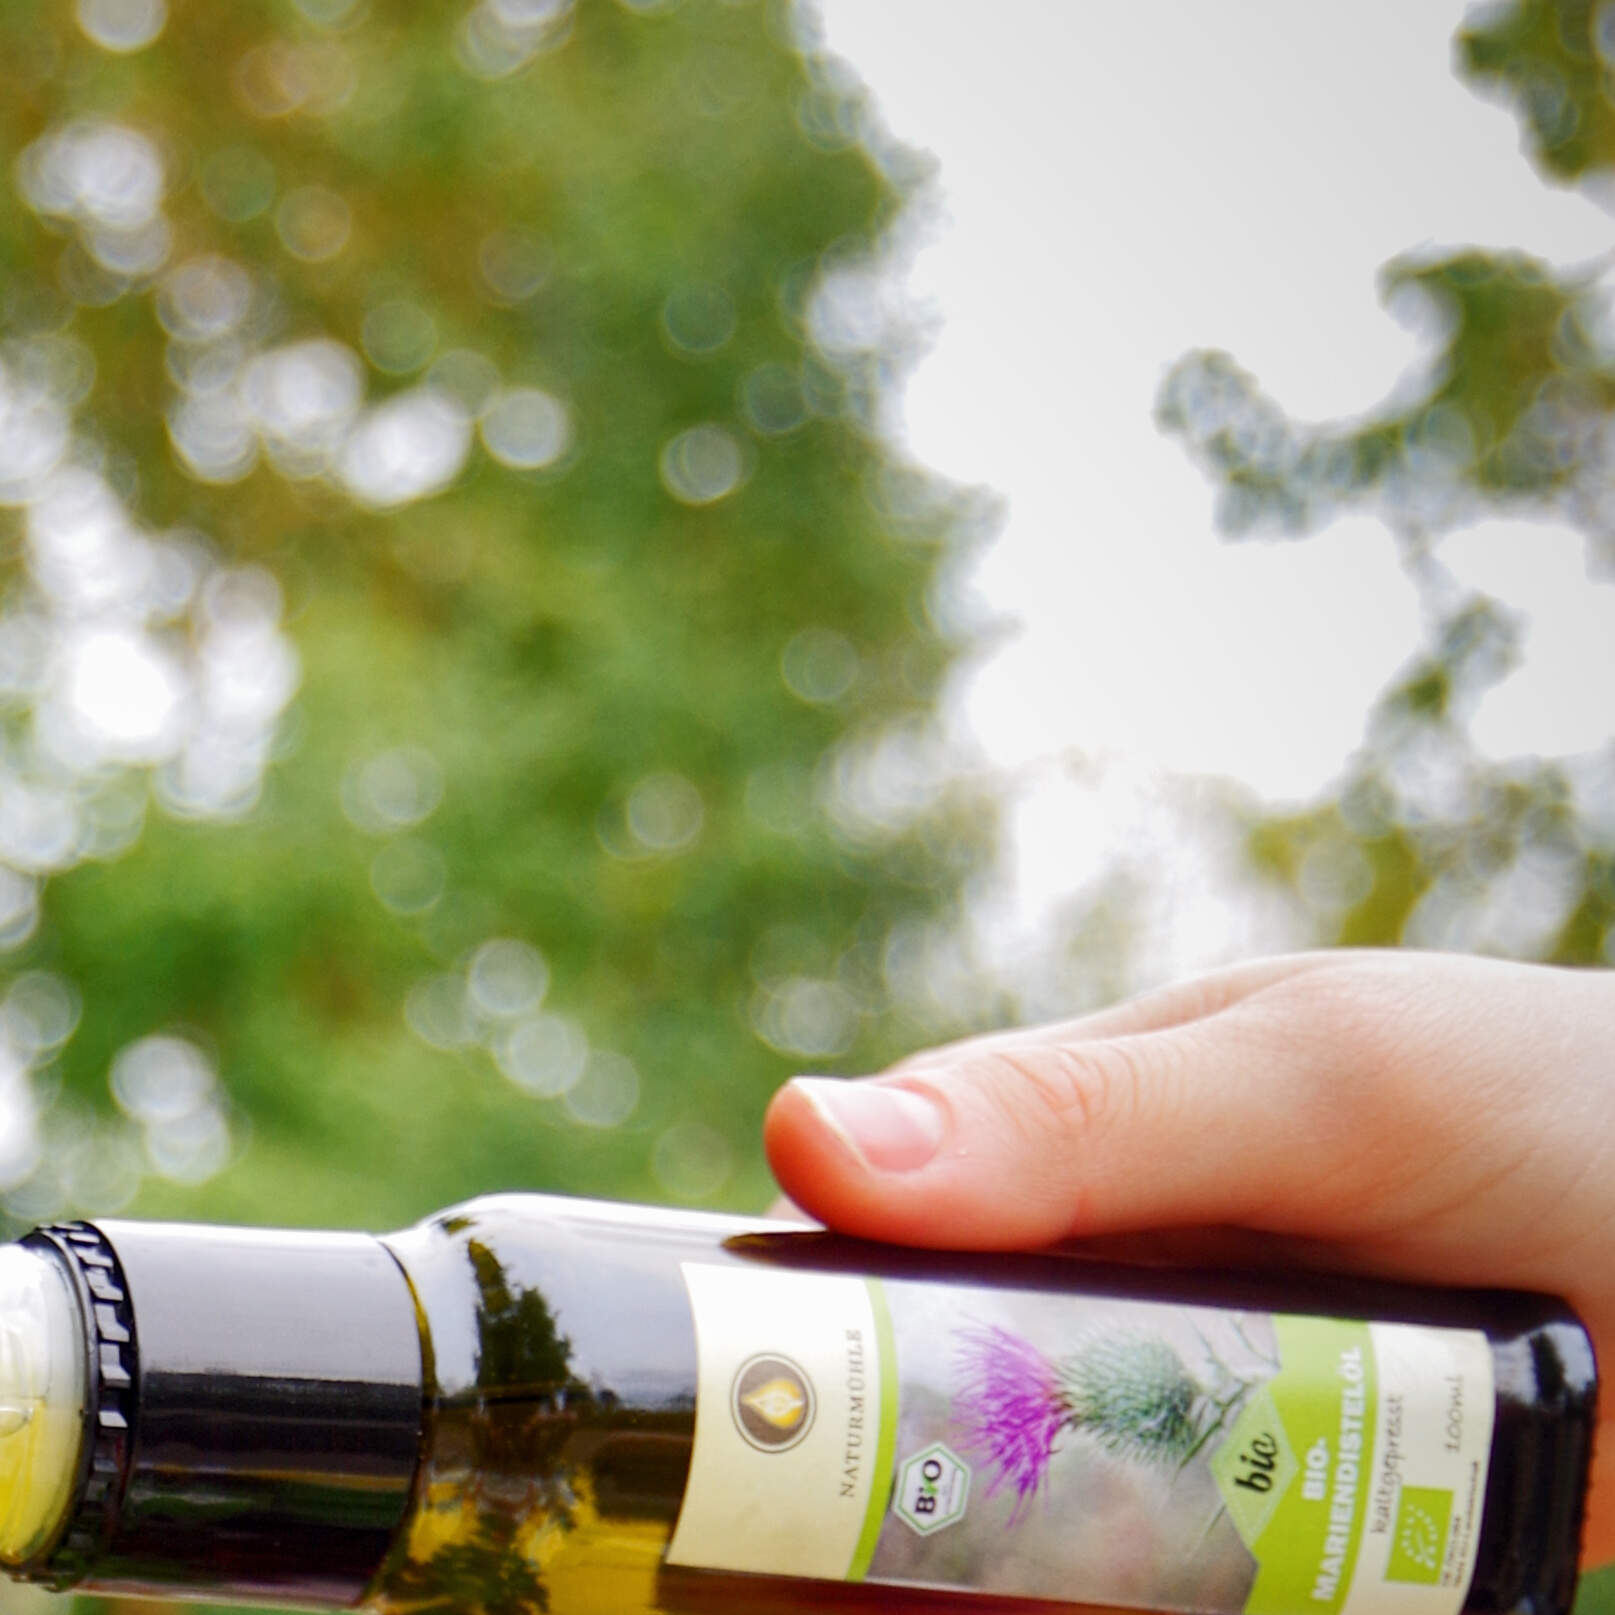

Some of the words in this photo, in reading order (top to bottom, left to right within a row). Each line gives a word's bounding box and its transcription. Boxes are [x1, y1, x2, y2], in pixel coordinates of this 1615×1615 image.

[840, 1329, 866, 1498] NATURMÜHLE
[1234, 1432, 1278, 1493] bio
[1301, 1436, 1329, 1501] BIO-
[1310, 1345, 1365, 1602] MARIENDISTELÖL
[1370, 1394, 1405, 1534] kaltgepresst
